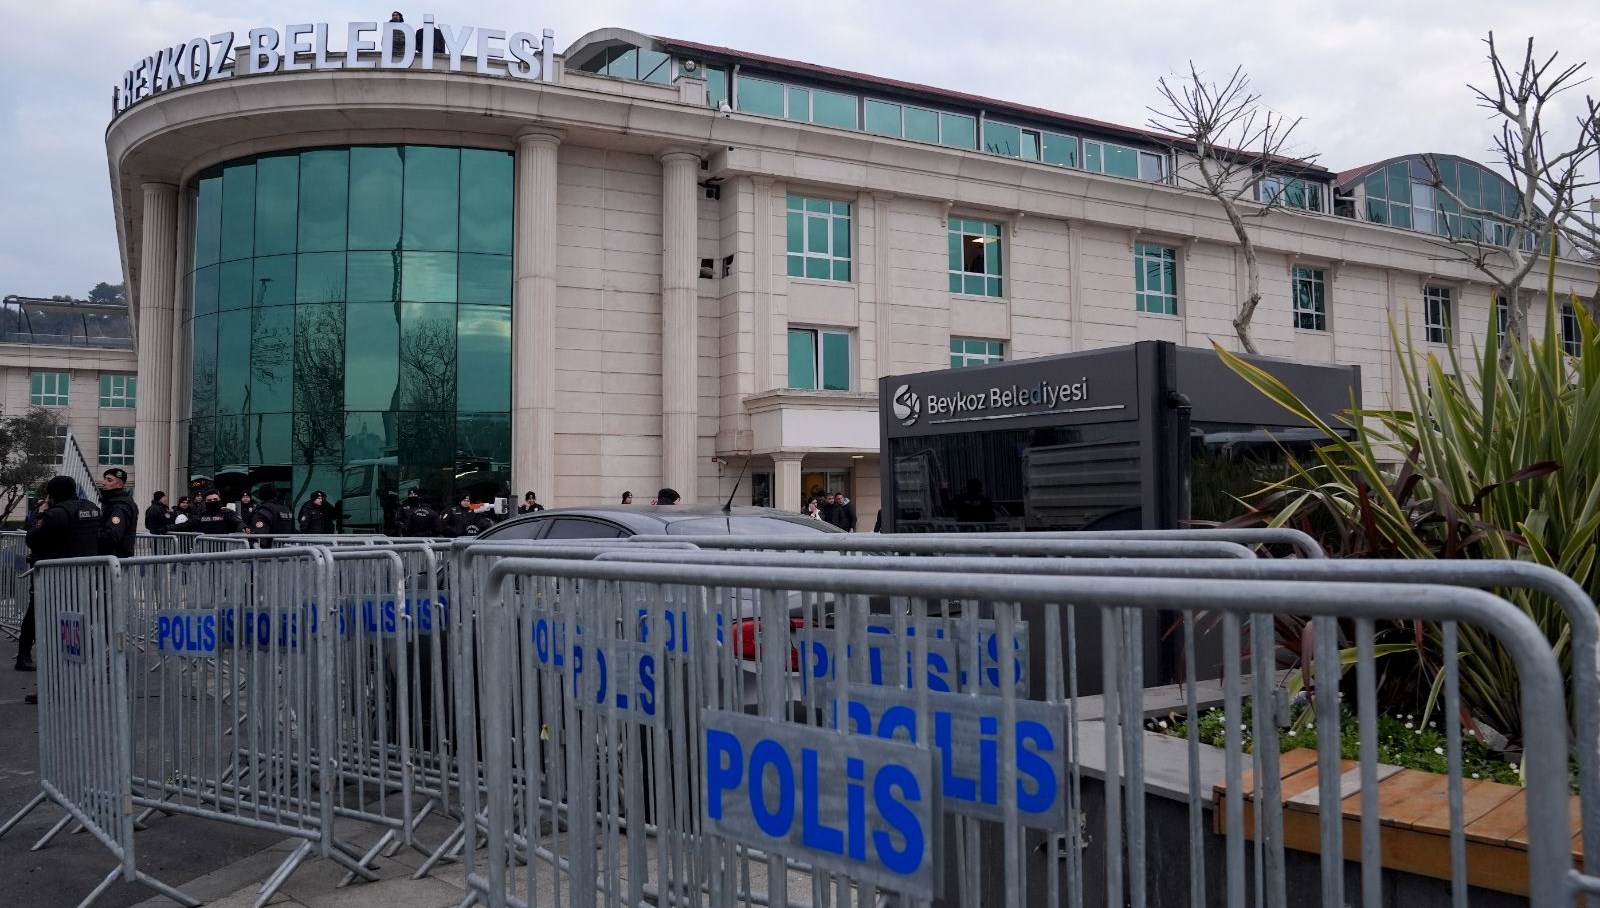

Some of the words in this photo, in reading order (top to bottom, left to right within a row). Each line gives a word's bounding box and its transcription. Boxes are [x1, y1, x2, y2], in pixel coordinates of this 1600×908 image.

[120, 31, 235, 111] BEYKOZ
[927, 391, 986, 416] Beykoz
[990, 377, 1089, 409] Belediyesi
